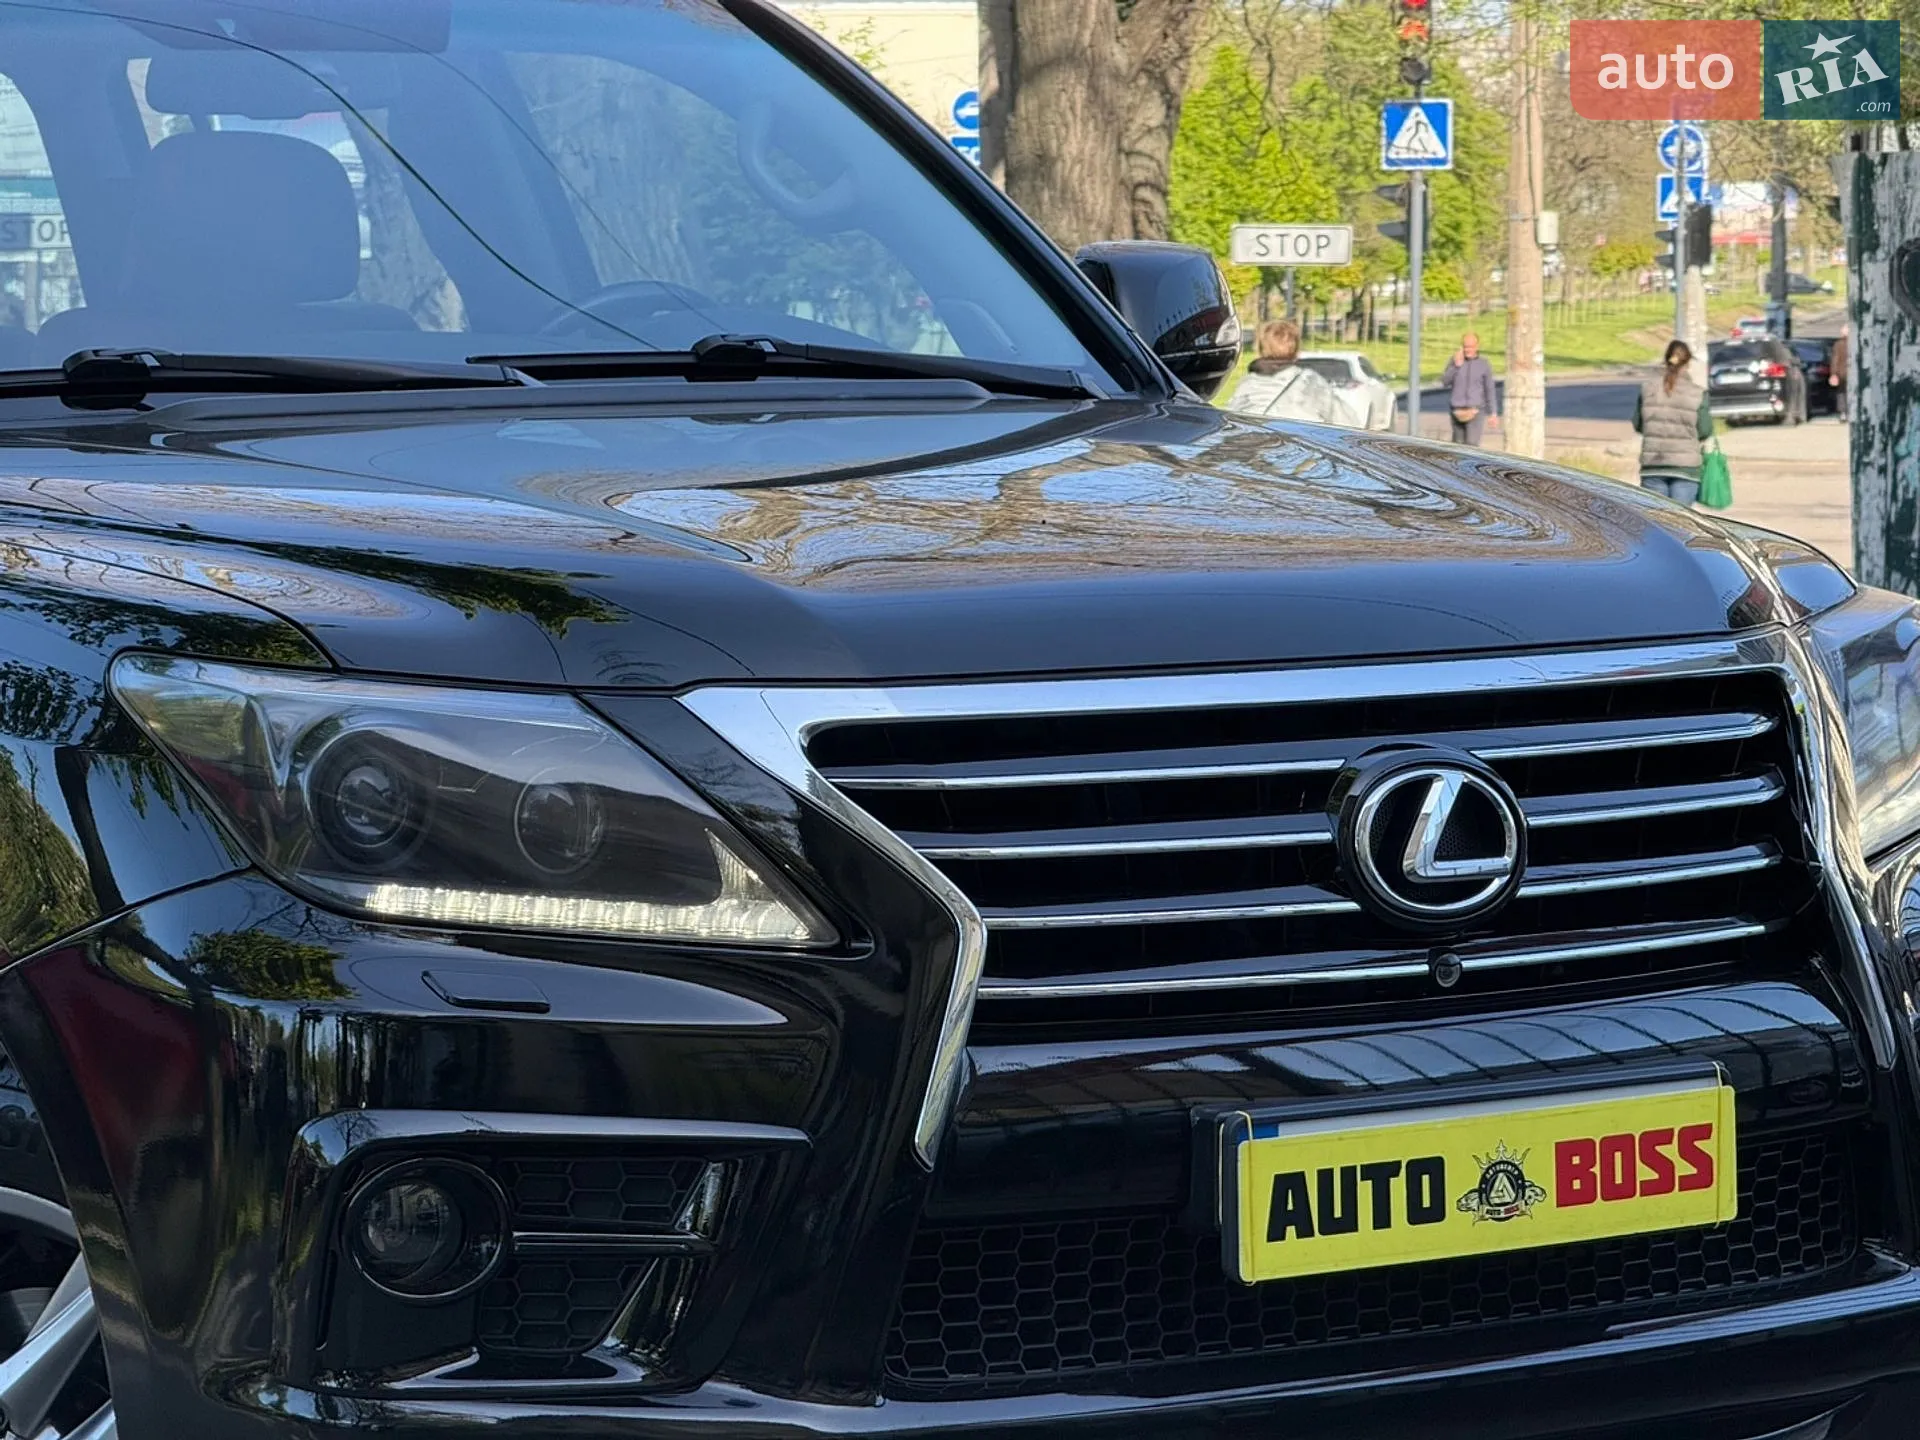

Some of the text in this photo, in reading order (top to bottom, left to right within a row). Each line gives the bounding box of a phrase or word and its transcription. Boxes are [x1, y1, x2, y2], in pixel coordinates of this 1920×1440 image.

[1255, 233, 1331, 257] STOP
[1266, 1122, 1714, 1243] AUTO BOSS
